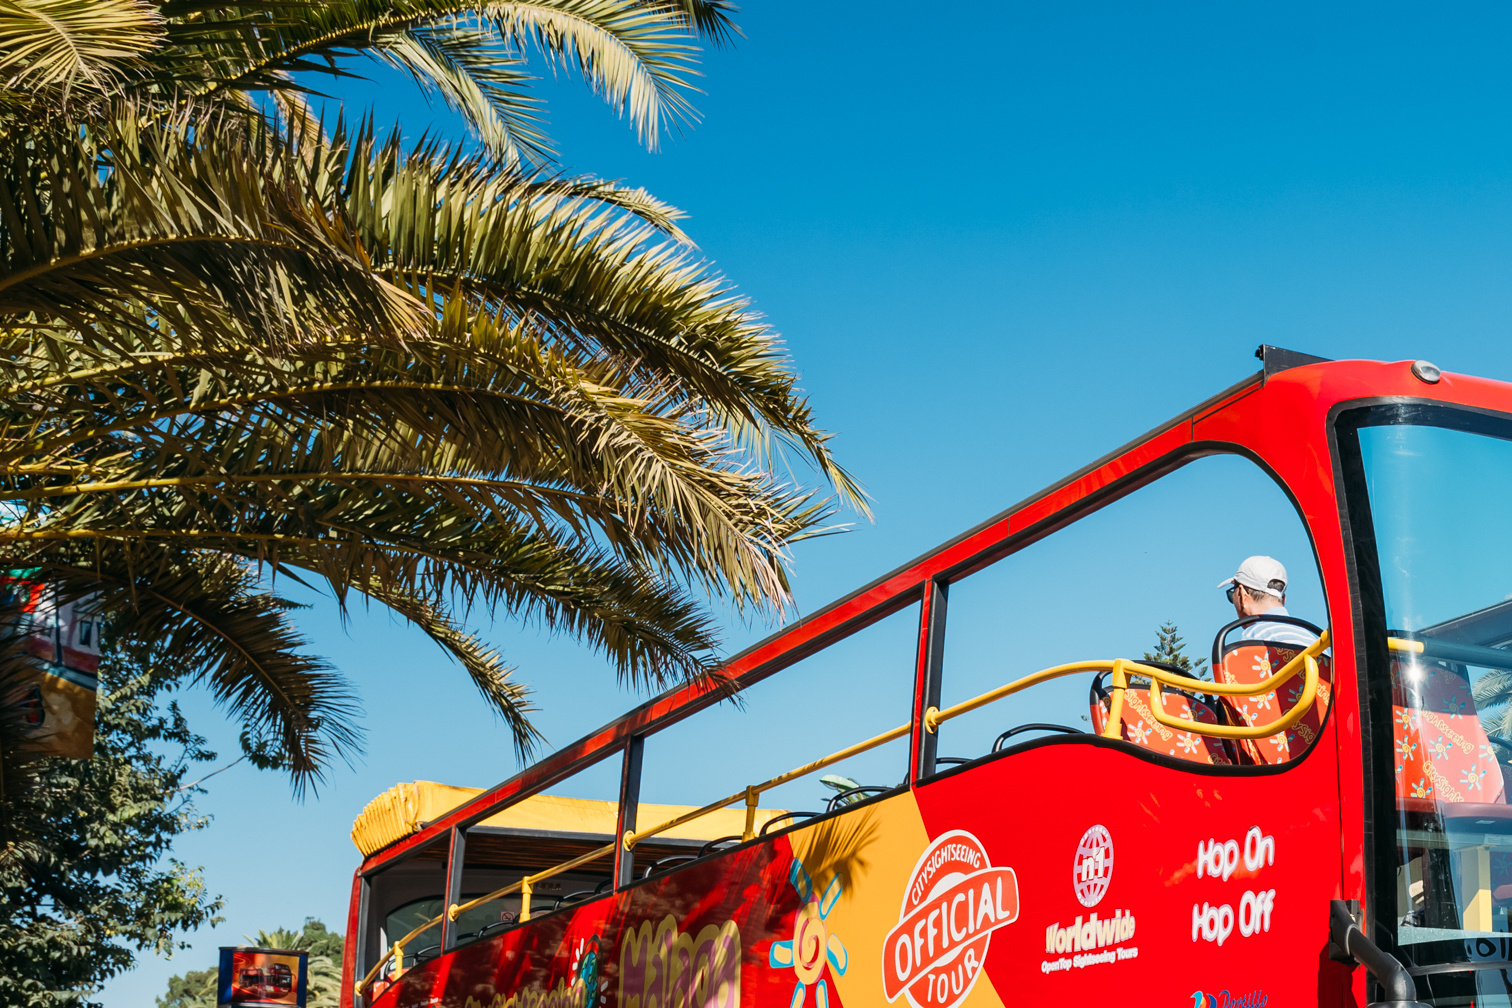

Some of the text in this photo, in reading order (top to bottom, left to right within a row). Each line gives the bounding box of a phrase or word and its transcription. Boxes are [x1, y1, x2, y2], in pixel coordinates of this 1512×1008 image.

[911, 843, 981, 905] CITYSIGHTSEEING
[1197, 825, 1275, 882] Hop On
[895, 876, 1010, 981] OFFICIAL
[1046, 908, 1135, 954] Worldwide
[1191, 889, 1276, 946] Hop Off
[927, 948, 979, 1003] TOUR
[1073, 950, 1116, 968] Sightseeing
[1117, 947, 1138, 960] Tours
